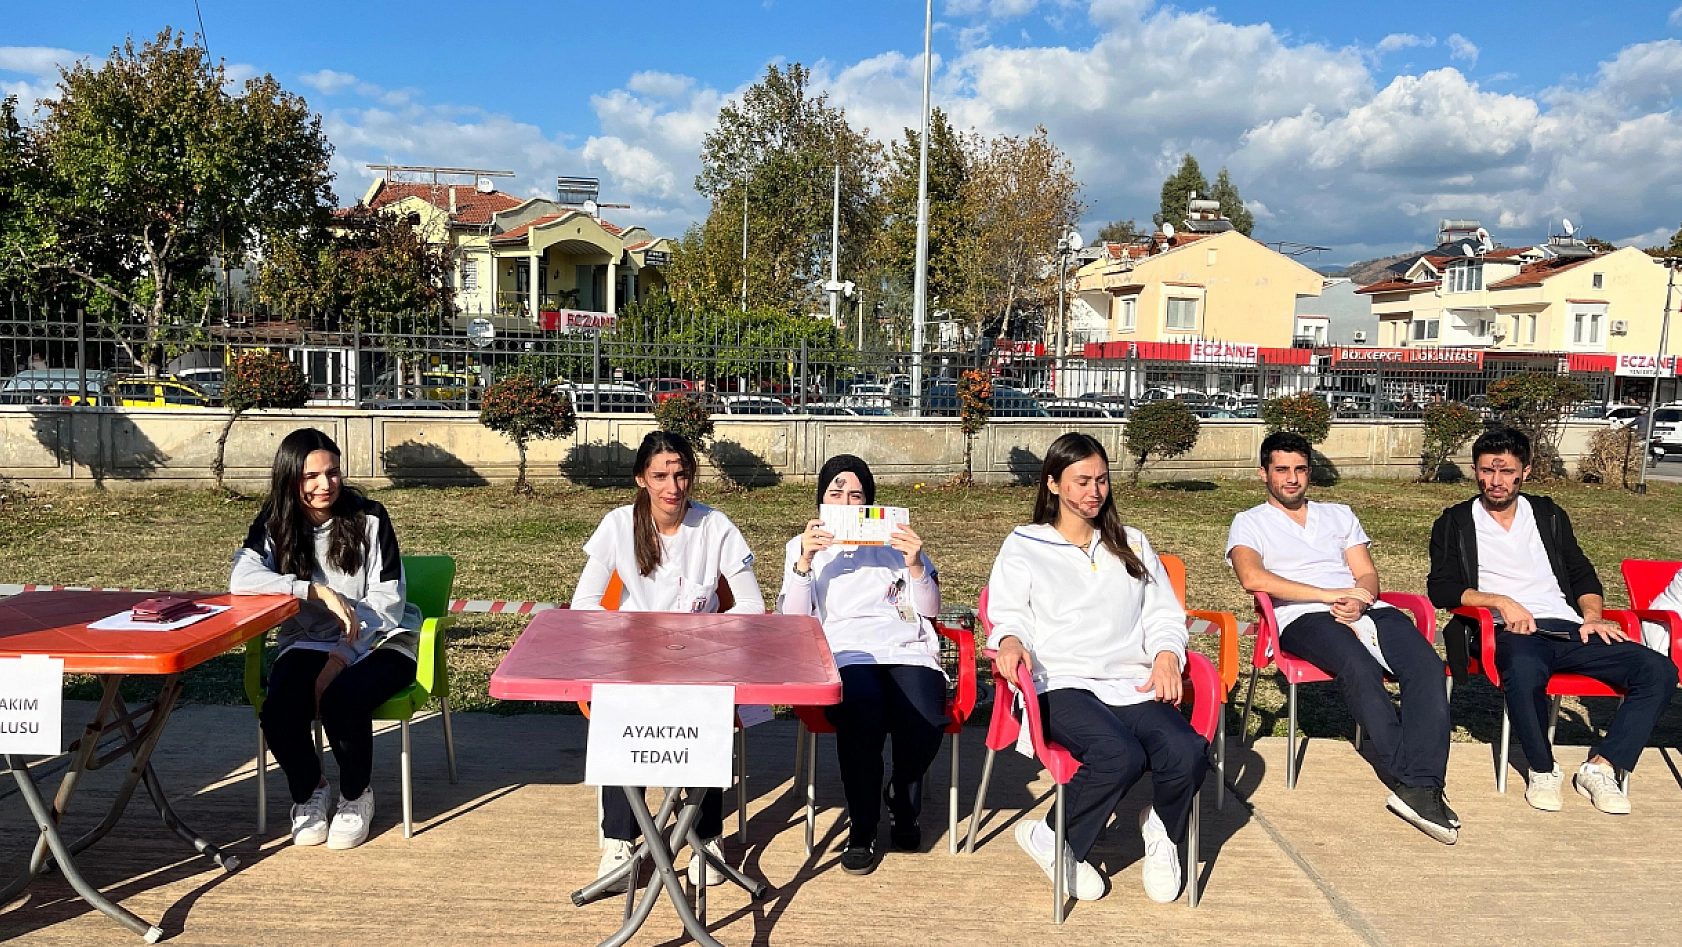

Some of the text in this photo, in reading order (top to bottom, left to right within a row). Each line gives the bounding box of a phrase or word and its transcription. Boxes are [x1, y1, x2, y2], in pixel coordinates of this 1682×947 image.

[1193, 344, 1255, 358] ECZANE
[1621, 355, 1672, 369] ECZANE
[623, 725, 699, 739] AYAKTAN
[630, 747, 689, 764] TEDAVİ
